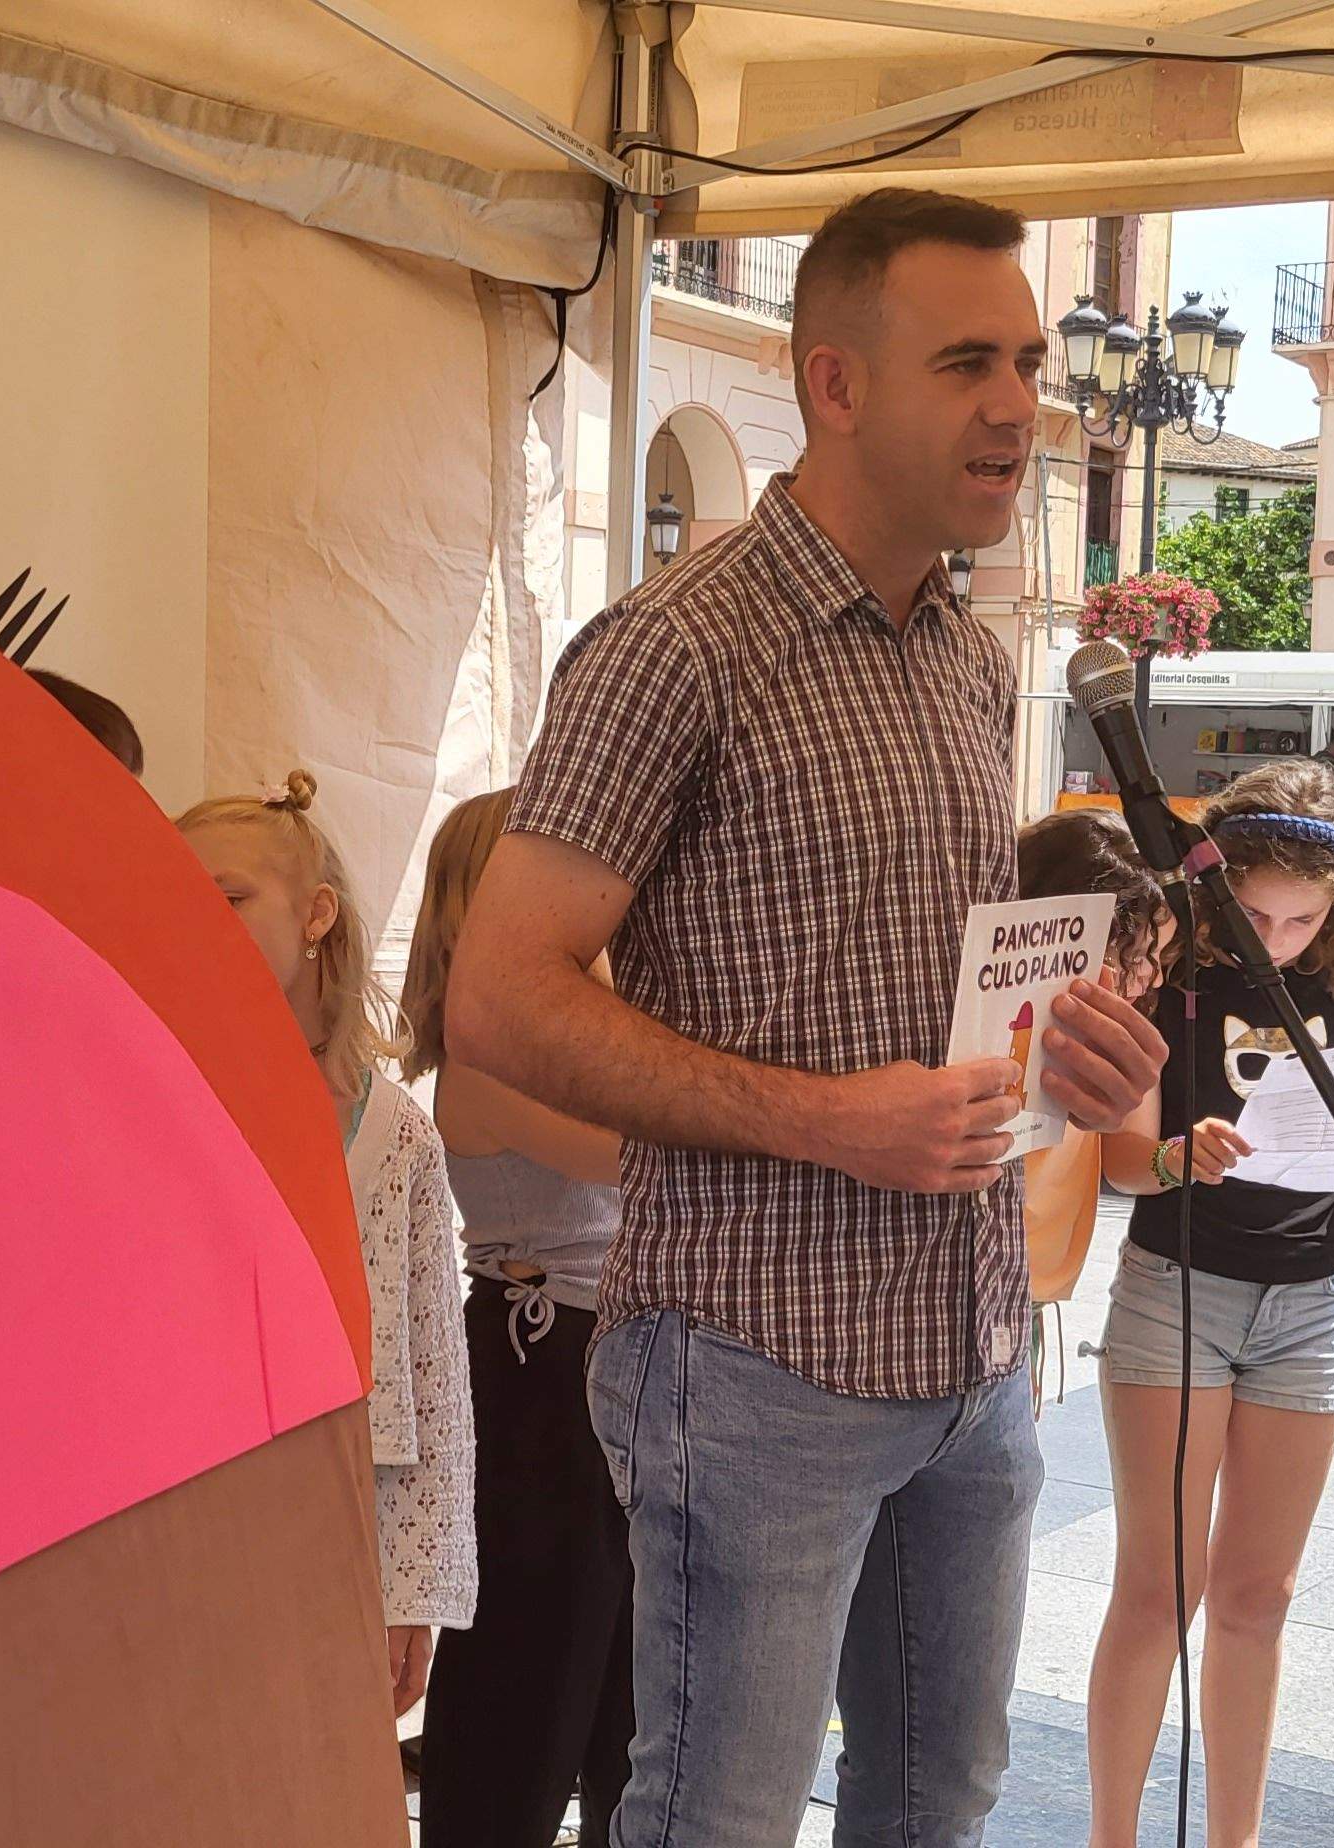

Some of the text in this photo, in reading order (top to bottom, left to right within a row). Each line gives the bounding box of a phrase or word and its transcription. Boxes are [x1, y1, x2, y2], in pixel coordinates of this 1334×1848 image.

[1151, 674, 1230, 684] Editorial Cosquillas
[992, 916, 1085, 955] PANCHITO
[978, 949, 1089, 992] CULO PLANO
